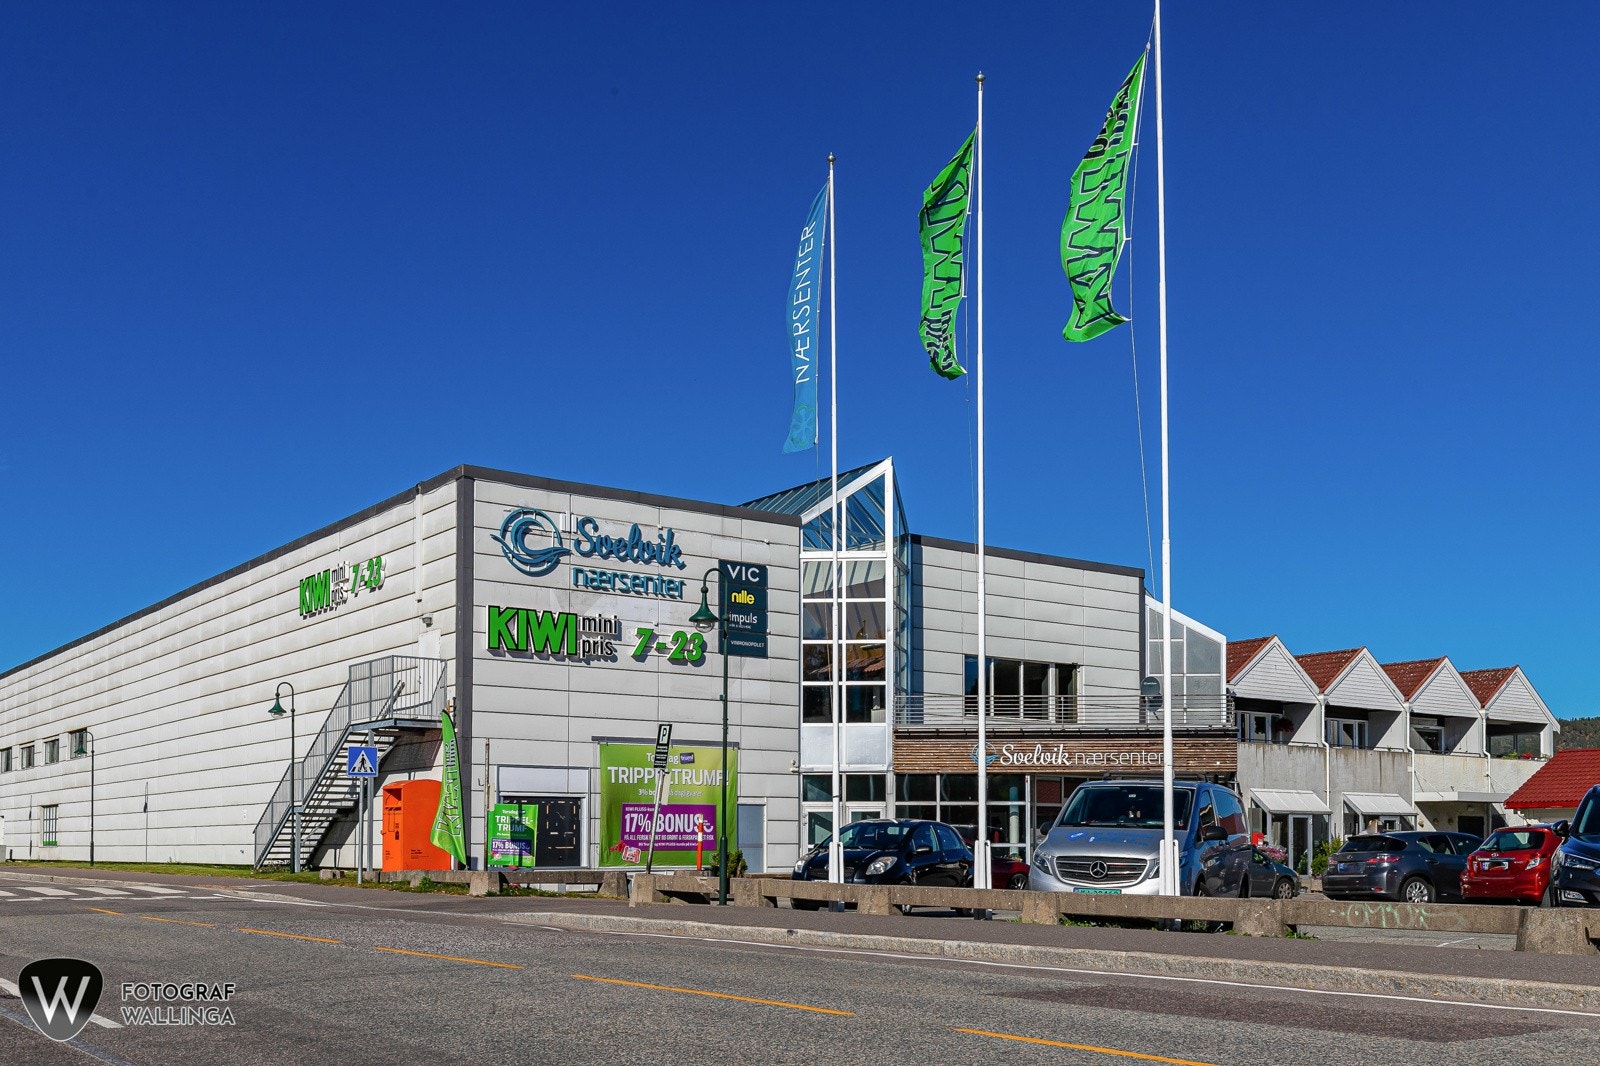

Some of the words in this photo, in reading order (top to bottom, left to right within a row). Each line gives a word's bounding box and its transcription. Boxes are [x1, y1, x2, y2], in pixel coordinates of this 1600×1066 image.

[792, 220, 816, 385] NÆRSENTER
[574, 516, 687, 571] Svelvik
[331, 560, 346, 583] mini
[572, 566, 687, 600] nærsenter
[727, 564, 760, 583] VIC
[299, 568, 331, 617] KIWI
[731, 590, 755, 605] nille
[581, 613, 618, 634] mini
[729, 611, 758, 626] impuls
[486, 605, 578, 656] KIWI
[581, 635, 614, 659] pris
[646, 752, 679, 765] Toag
[1000, 743, 1072, 766] Svelvik
[1075, 749, 1165, 765] nærsenter
[624, 813, 652, 833] 17%
[656, 813, 703, 833] BONUS
